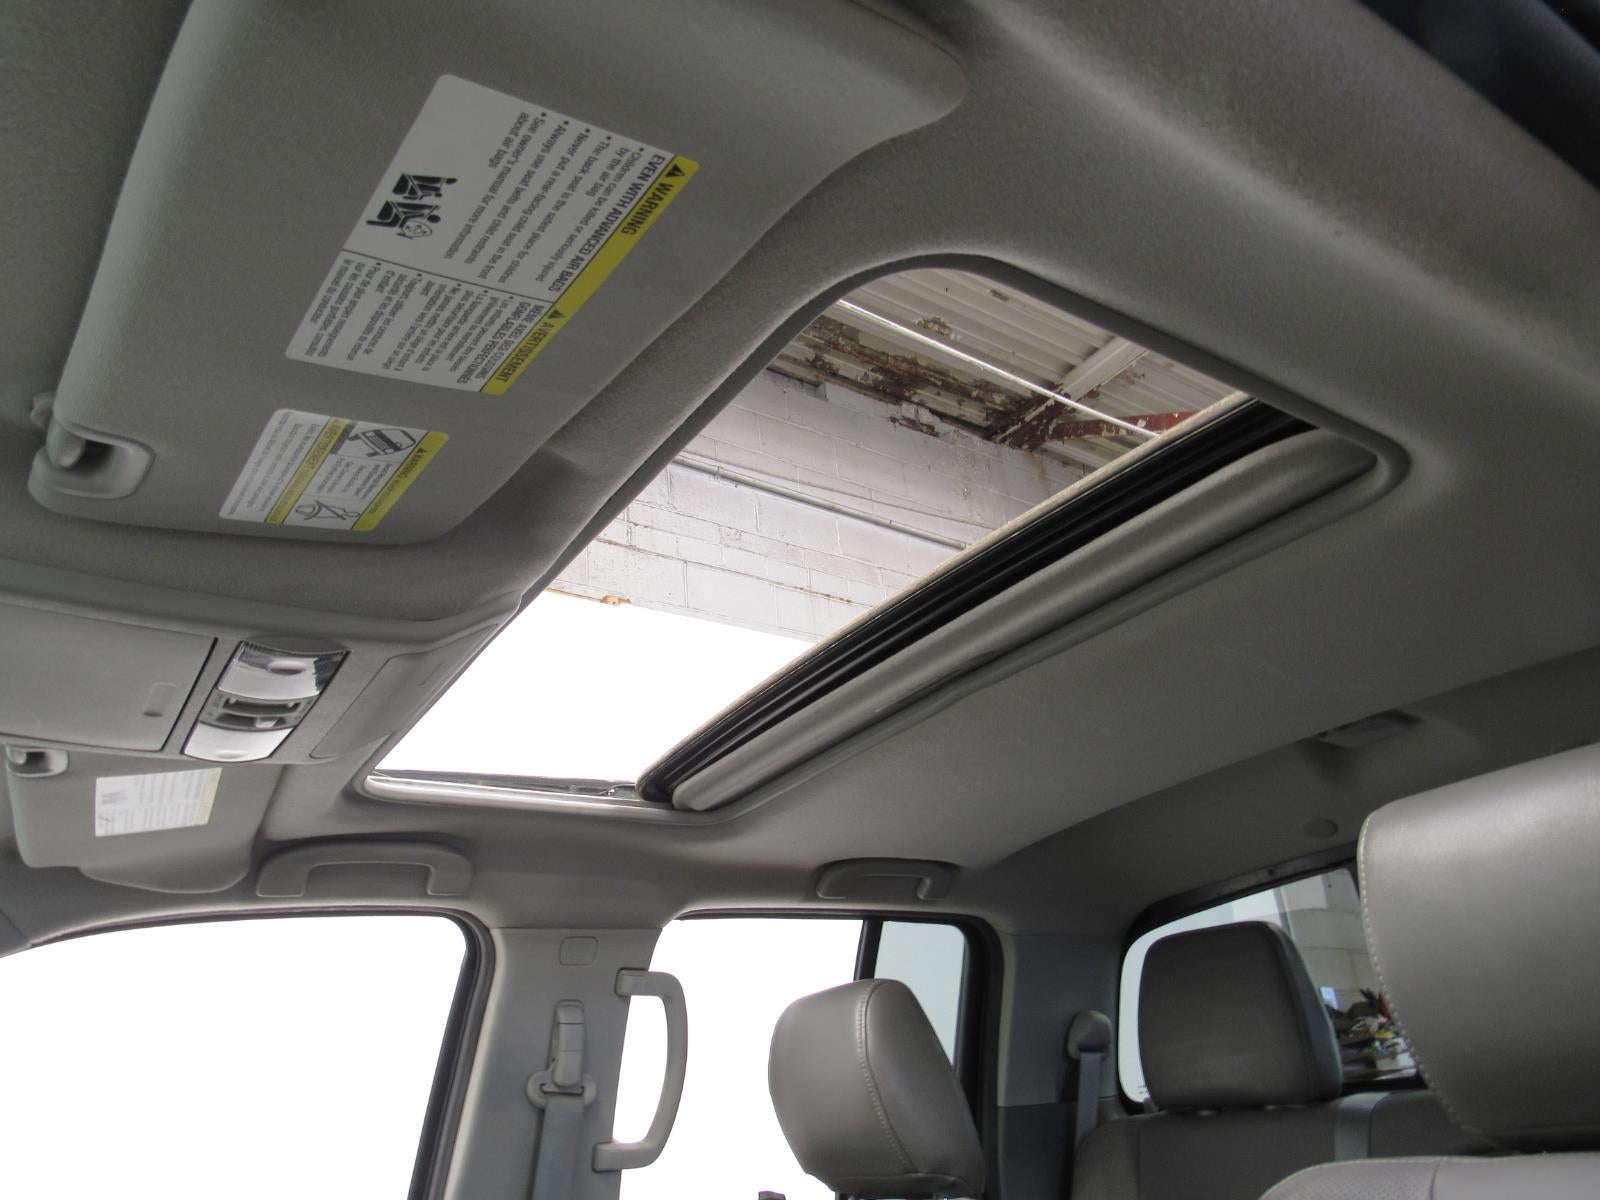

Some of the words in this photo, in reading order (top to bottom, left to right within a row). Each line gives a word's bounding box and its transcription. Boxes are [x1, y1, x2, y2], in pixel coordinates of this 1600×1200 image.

[636, 154, 665, 181] EVEN
[615, 182, 644, 208] WITH
[620, 181, 674, 235] WARNING
[578, 207, 622, 255] ADVANCED
[565, 254, 584, 270] AIR
[547, 269, 573, 292] BAGS
